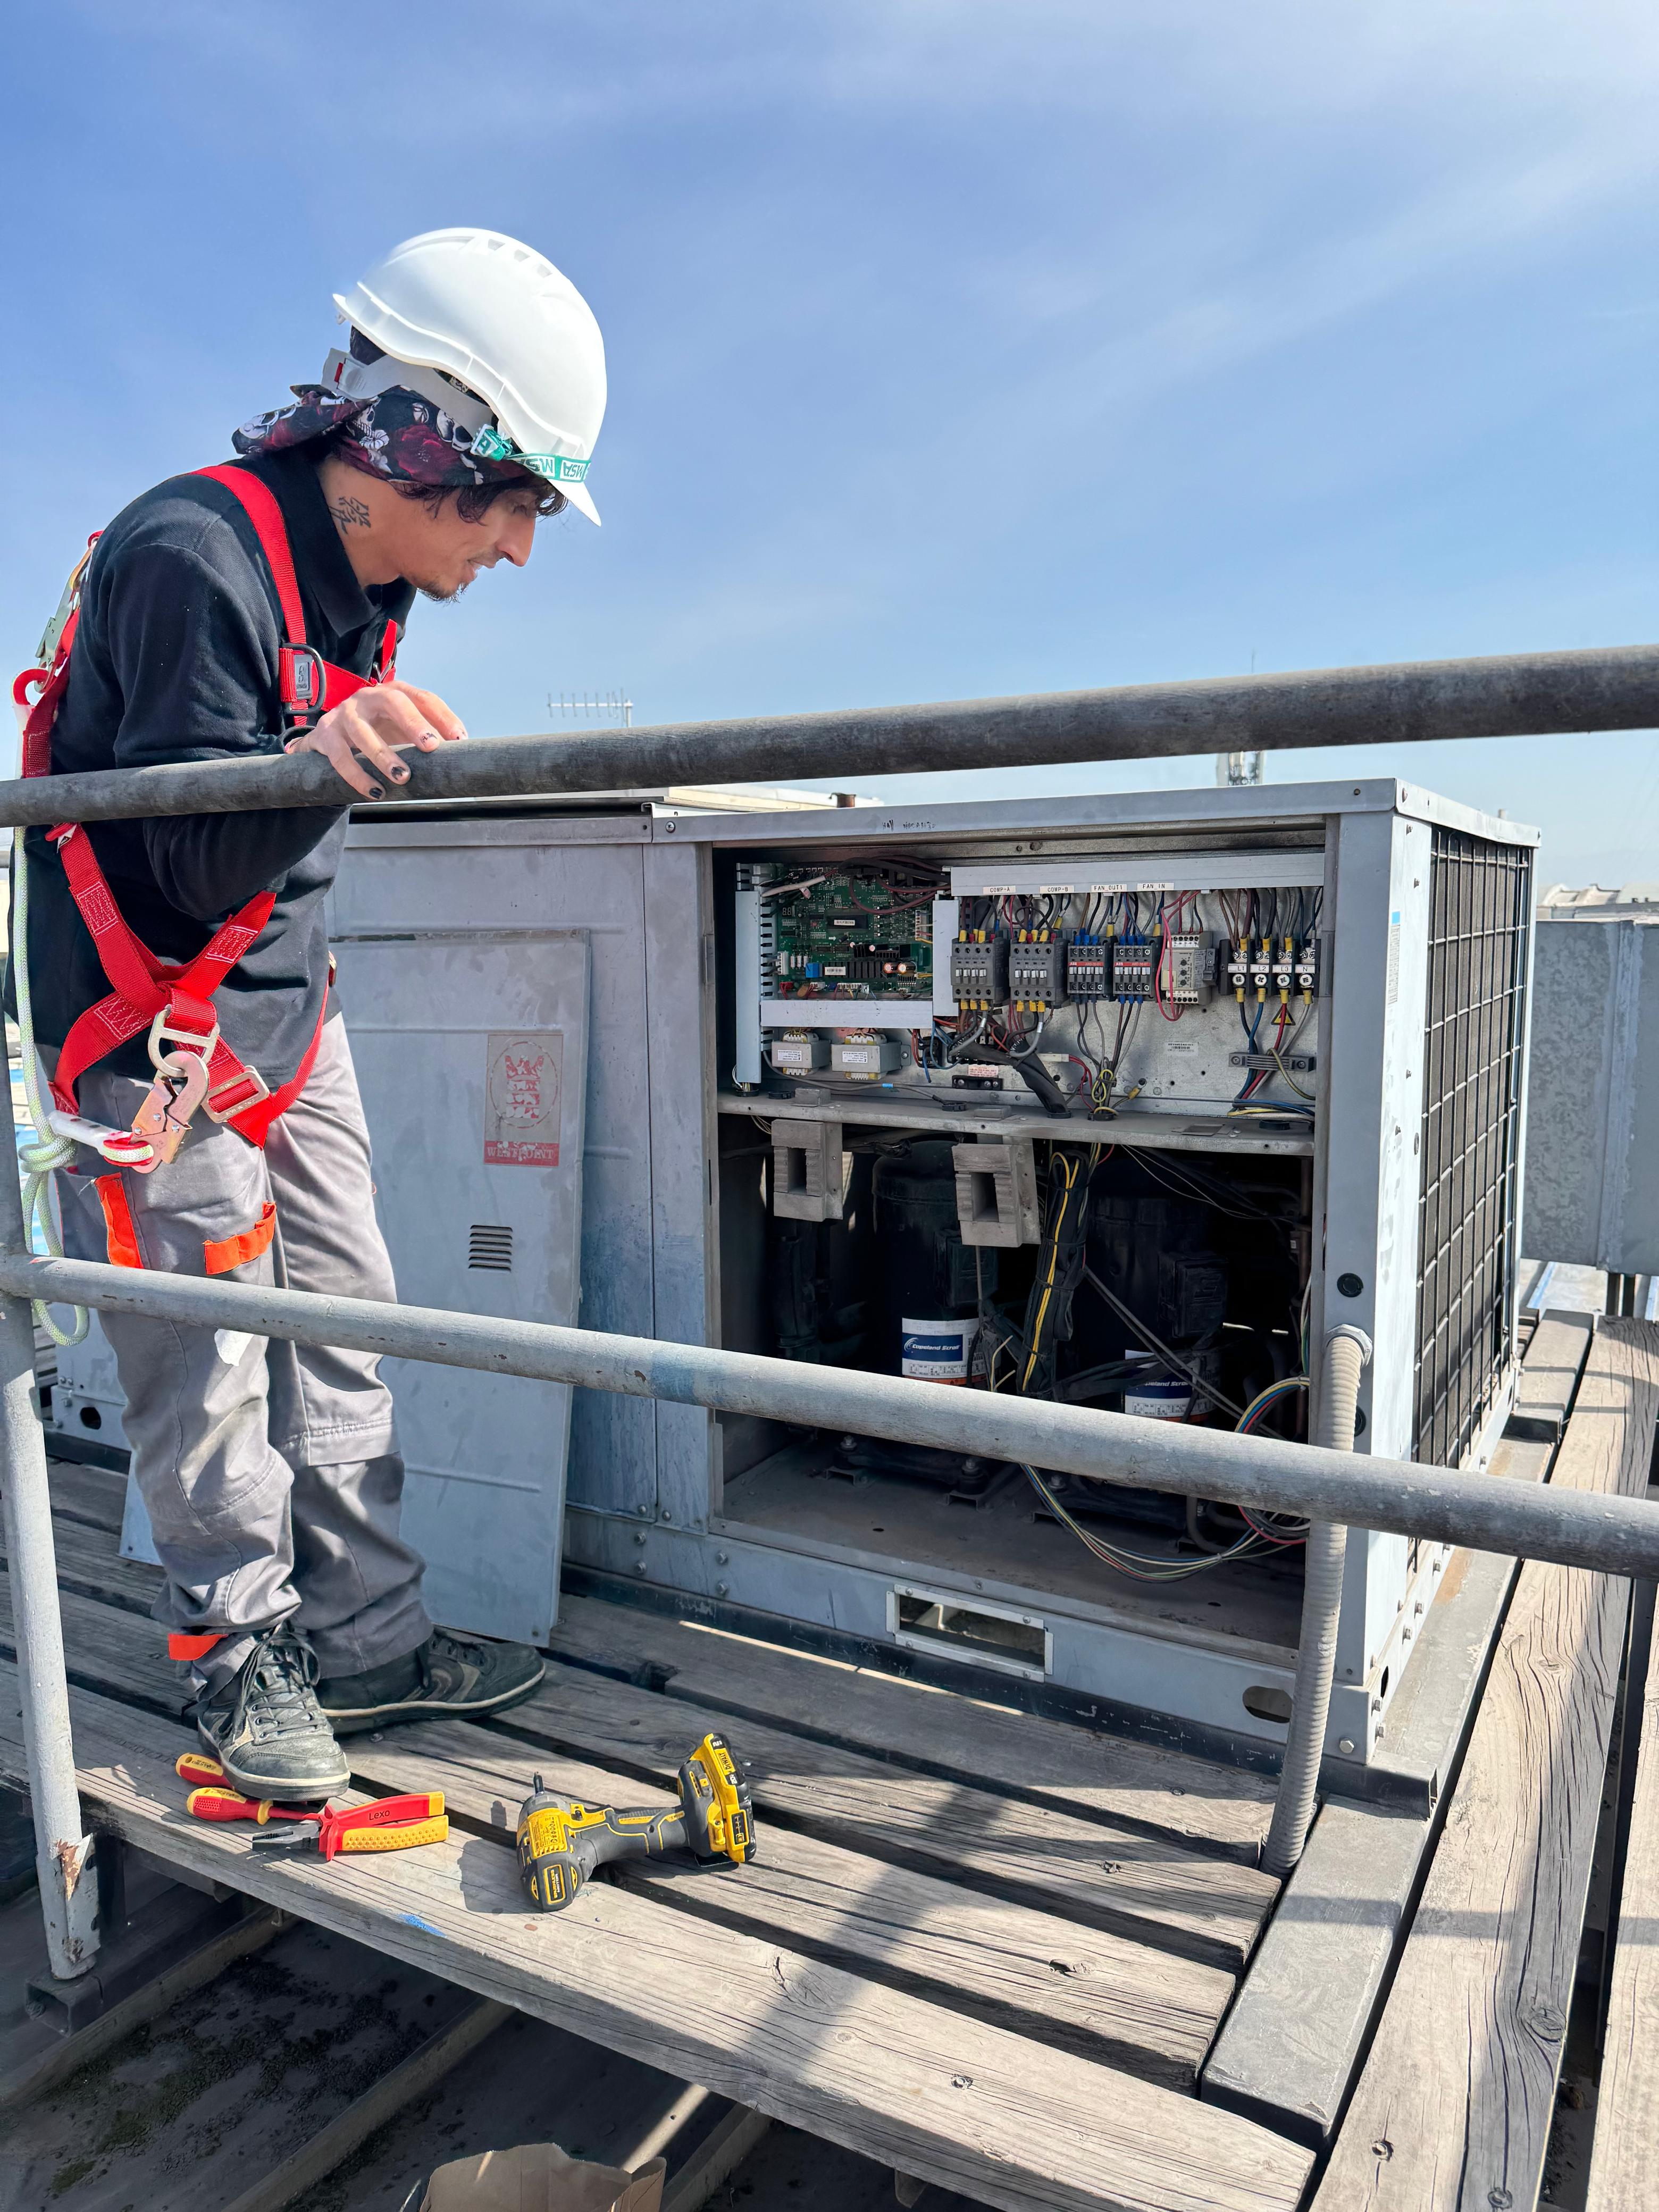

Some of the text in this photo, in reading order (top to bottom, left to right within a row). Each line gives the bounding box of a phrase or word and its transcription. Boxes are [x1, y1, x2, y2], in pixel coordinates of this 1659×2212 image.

[563, 462, 584, 478] MSA
[719, 1753, 731, 1770] DeWALT
[368, 1809, 390, 1822] Lexo
